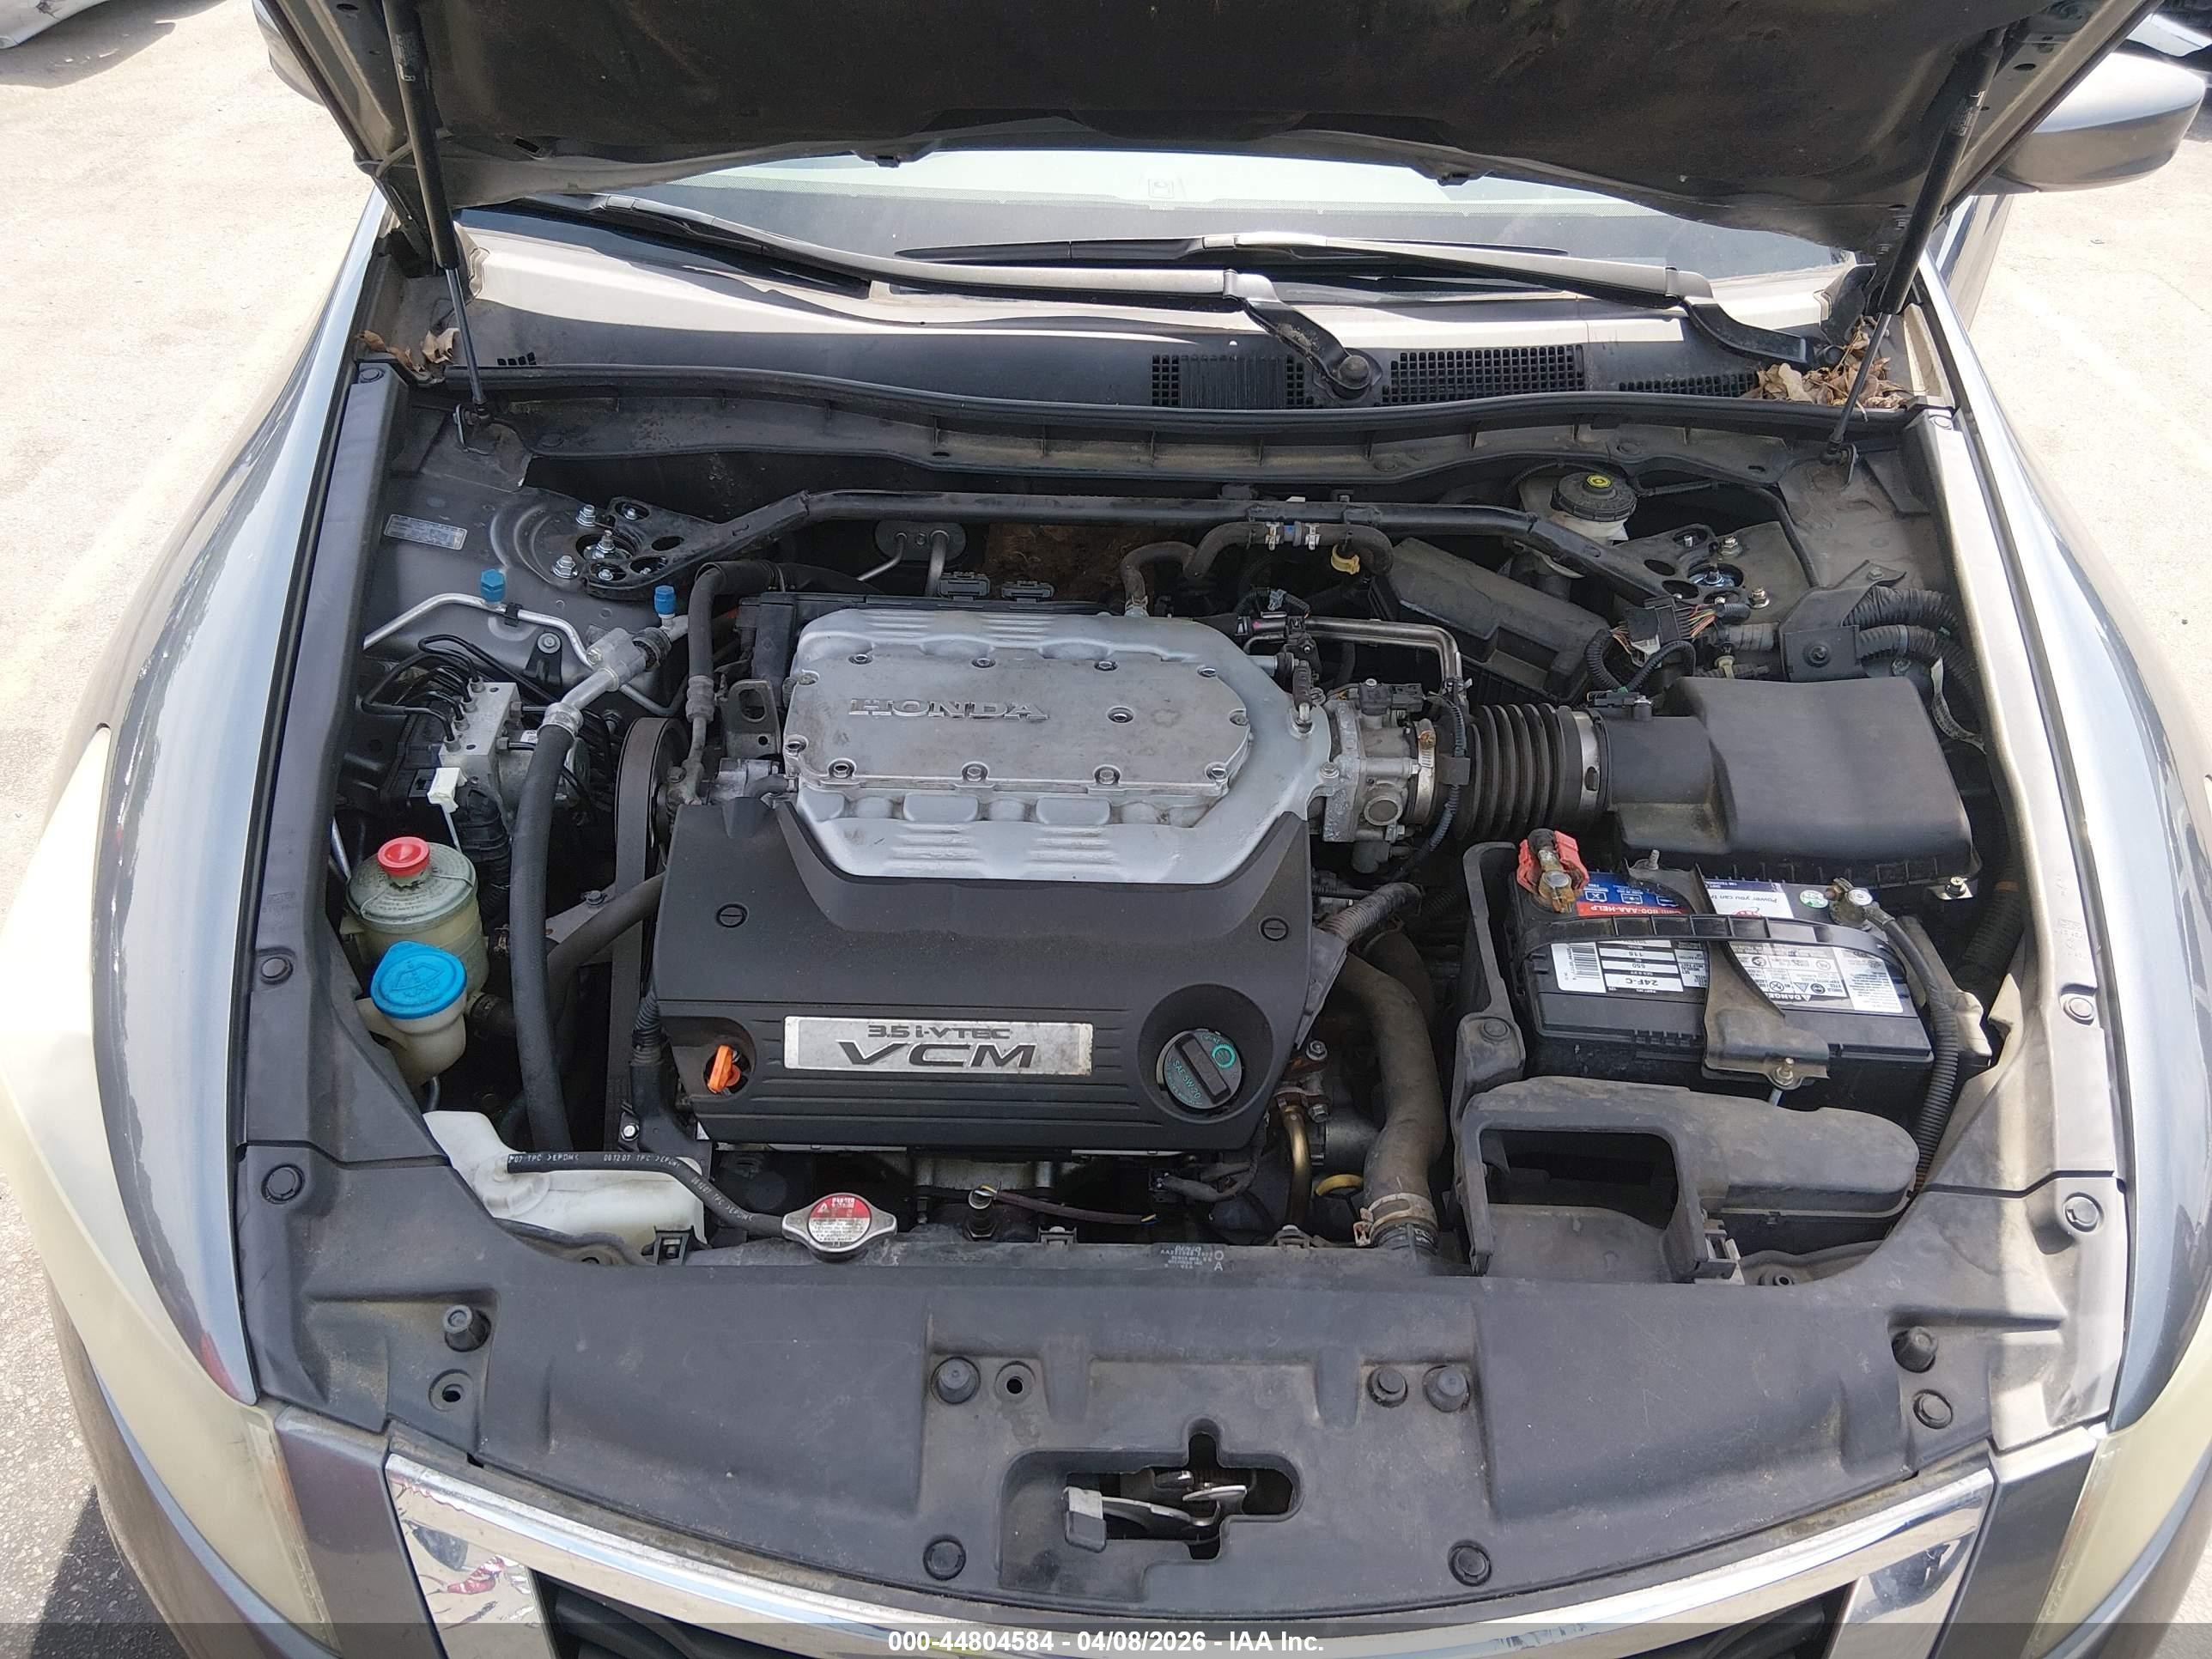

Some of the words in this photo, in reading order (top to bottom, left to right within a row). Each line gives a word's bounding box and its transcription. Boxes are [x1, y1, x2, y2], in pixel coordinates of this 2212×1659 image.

[848, 699, 1049, 720] HONDA
[868, 1024, 910, 1038] 3.5
[915, 1025, 1011, 1039] i-VTEC
[836, 1039, 1036, 1068] VCM
[1173, 1060, 1186, 1075] SAE
[1183, 1075, 1201, 1099] 5W-20
[527, 1153, 542, 1162] TPC
